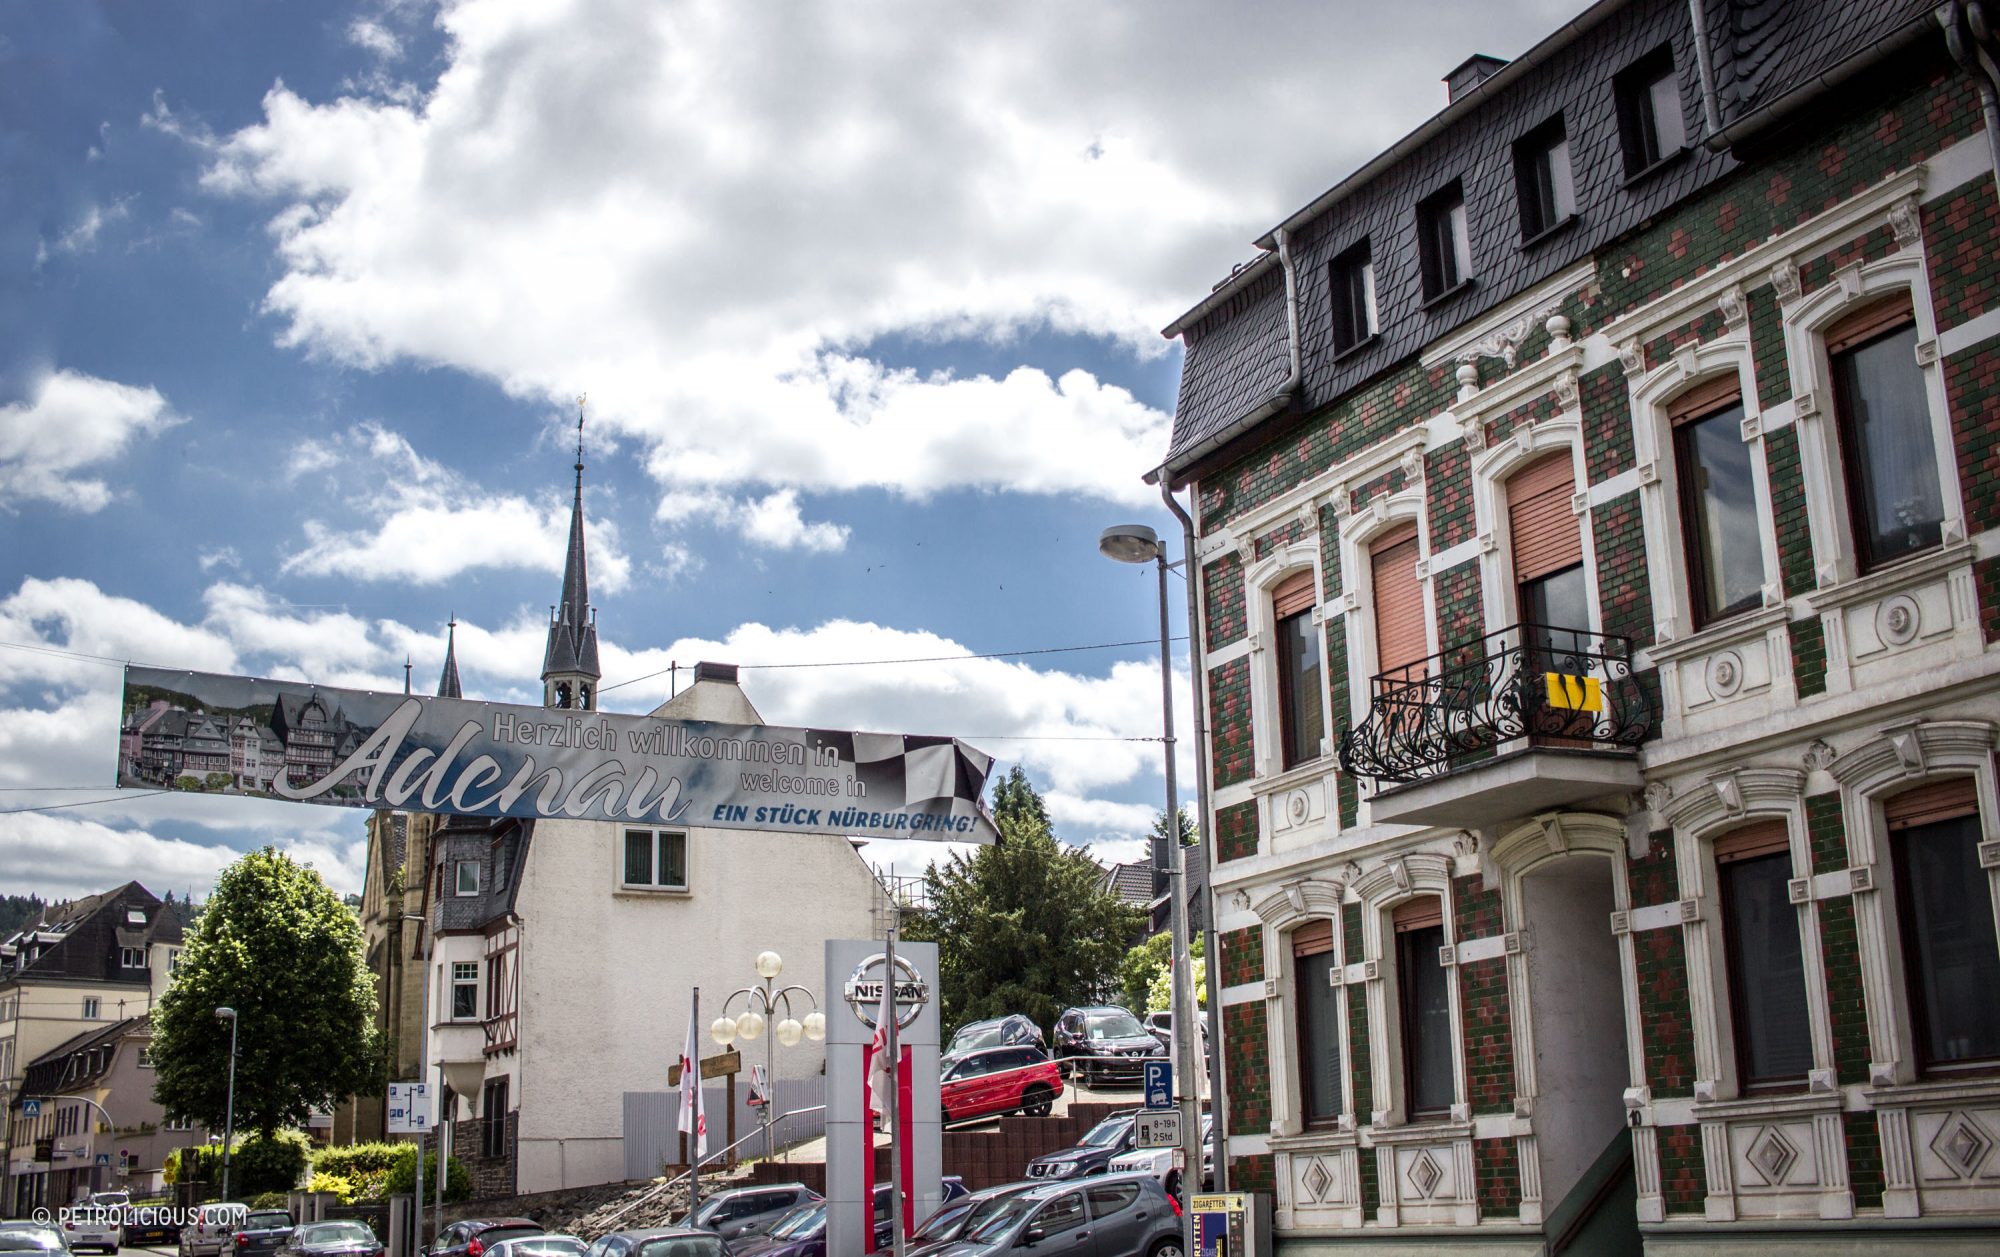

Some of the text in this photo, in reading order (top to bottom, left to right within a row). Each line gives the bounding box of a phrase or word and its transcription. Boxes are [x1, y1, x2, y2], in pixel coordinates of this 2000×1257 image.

[493, 712, 840, 768] Herzlich willkommen in
[273, 698, 692, 821] Adenau
[741, 769, 867, 797] welcome in
[713, 803, 979, 833] EIN STÜCK NÜRBURGRING!
[855, 984, 923, 999] NISAN
[1149, 1066, 1162, 1087] P
[1193, 1199, 1226, 1209] ZIGARETTEN
